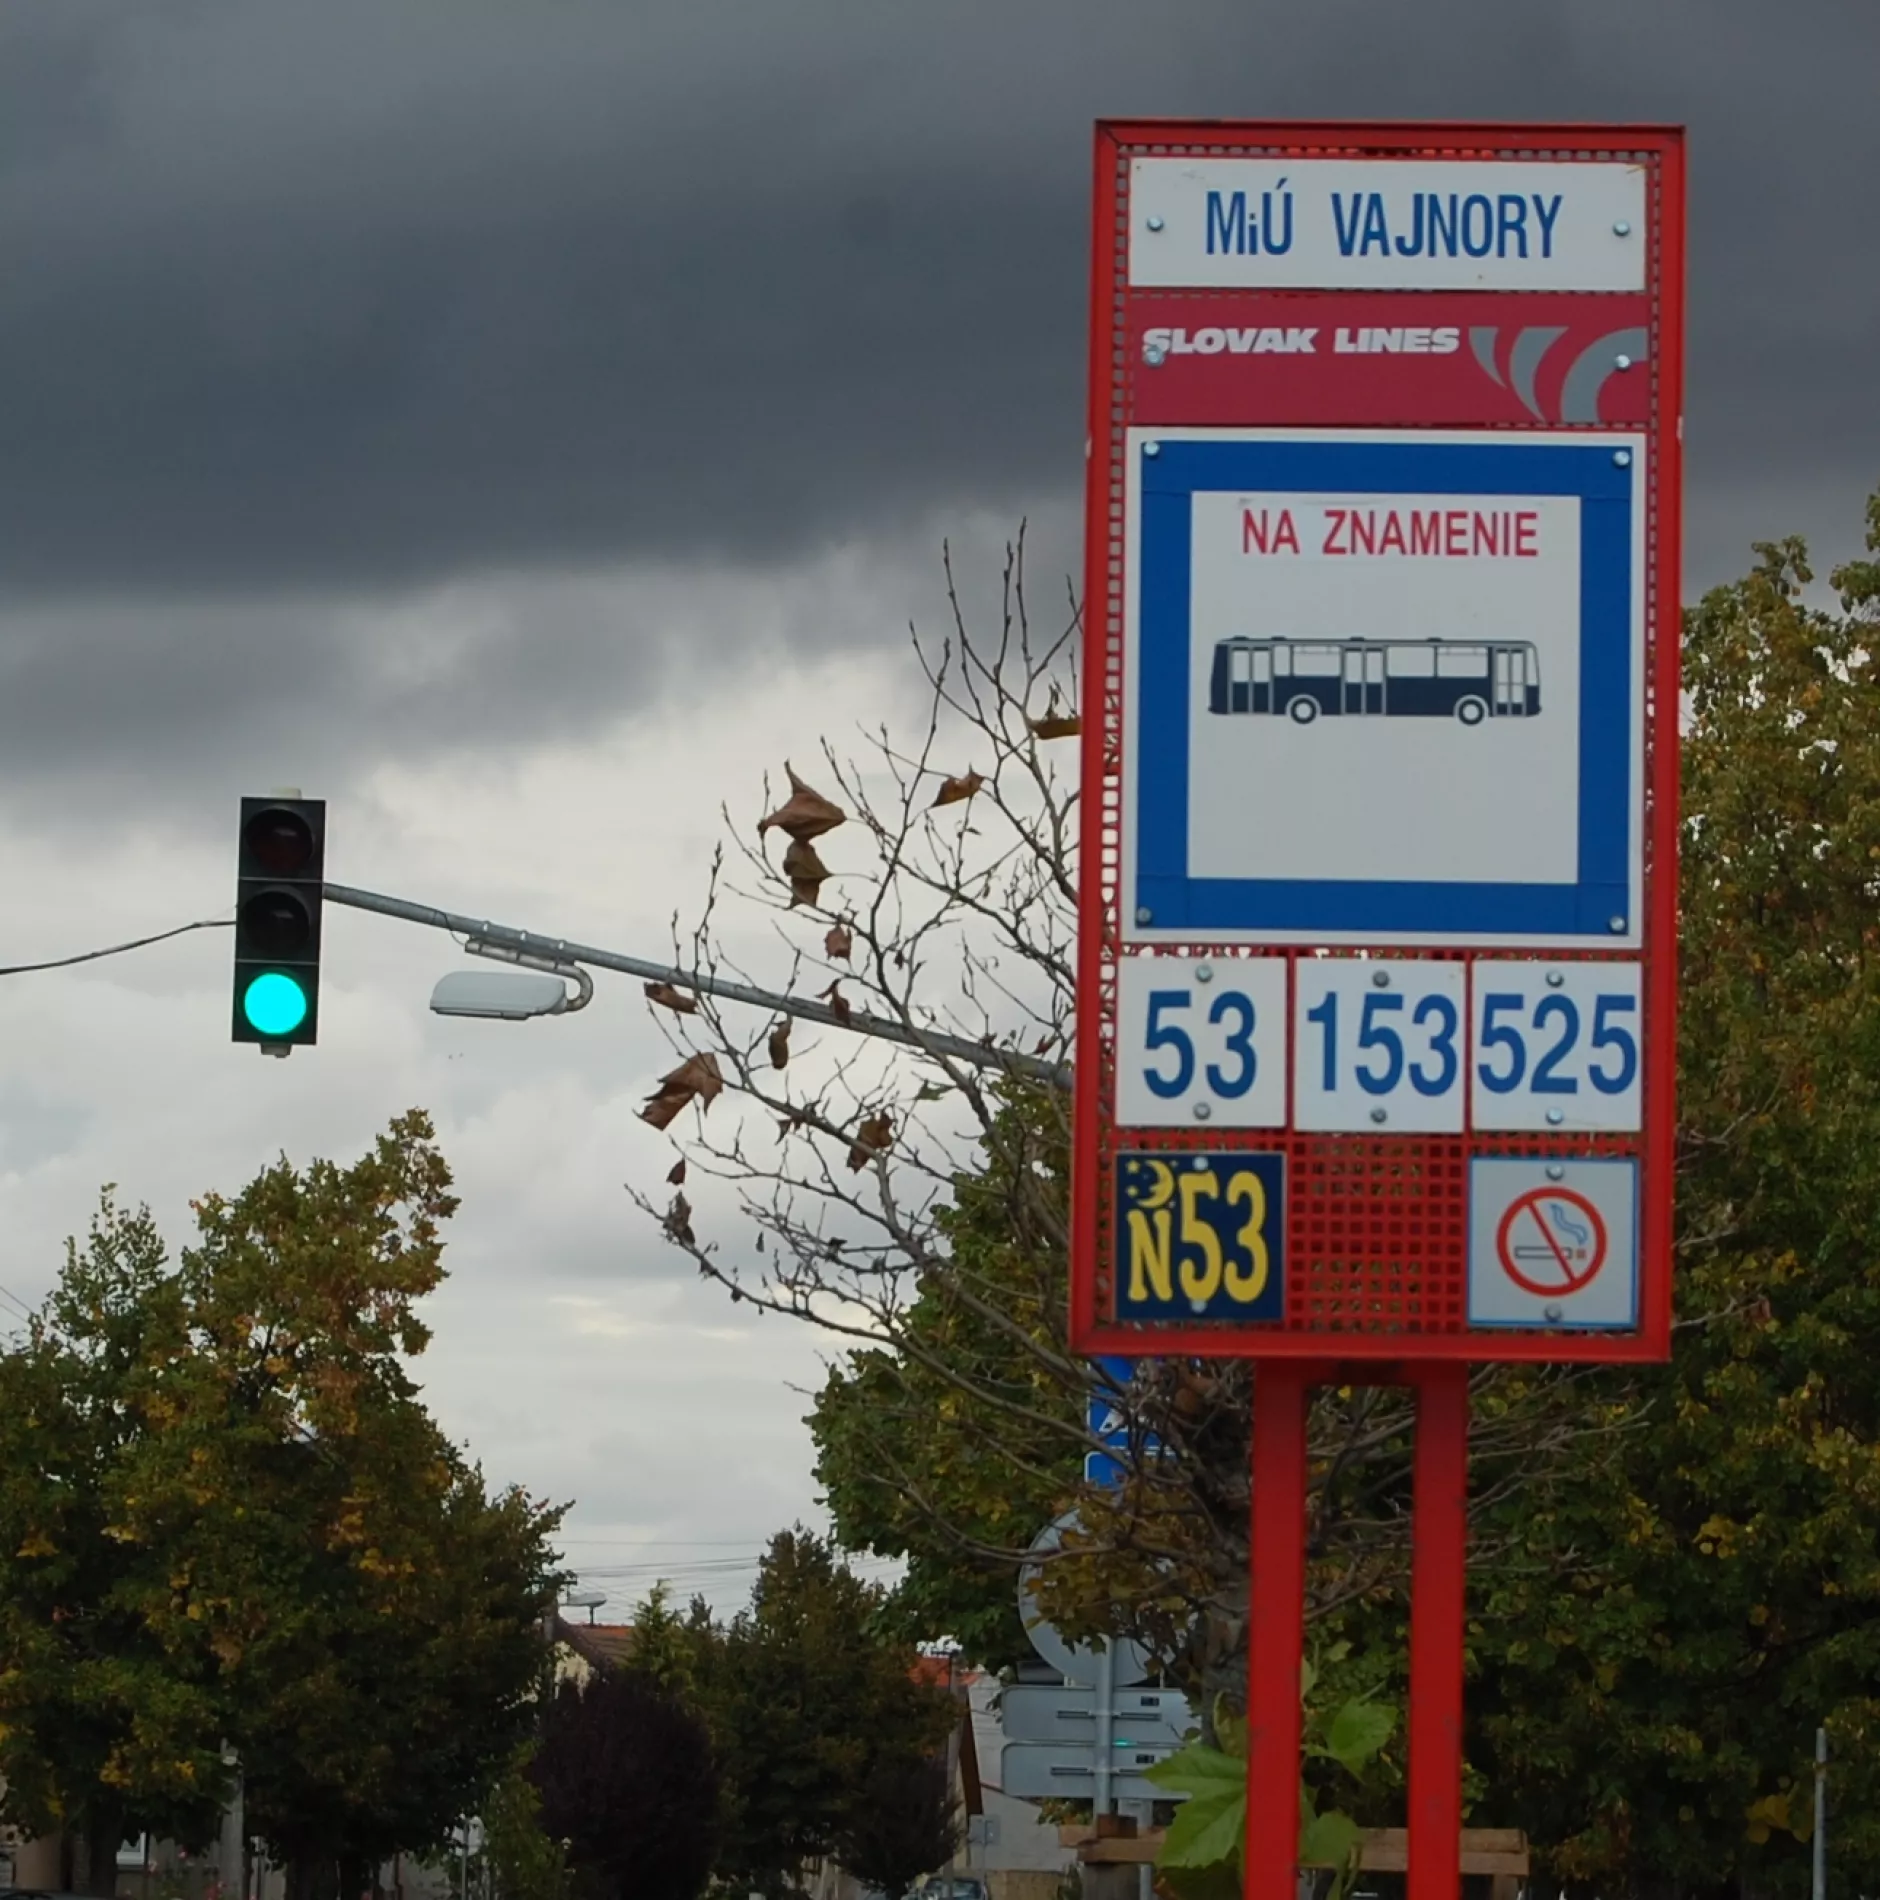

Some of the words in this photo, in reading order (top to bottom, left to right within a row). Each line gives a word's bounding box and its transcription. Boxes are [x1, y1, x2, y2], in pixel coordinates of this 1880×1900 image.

[1206, 177, 1294, 256] MiÚ
[1330, 192, 1564, 259] VAJNORY
[1142, 326, 1320, 354] SLOVAK
[1333, 326, 1461, 354] LINES
[1241, 508, 1300, 555] NA
[1321, 509, 1539, 557] ZNAMENIE
[1142, 989, 1257, 1099] 53
[1307, 991, 1458, 1097] 153
[1477, 993, 1637, 1095] 525
[1126, 1170, 1269, 1303] N53
